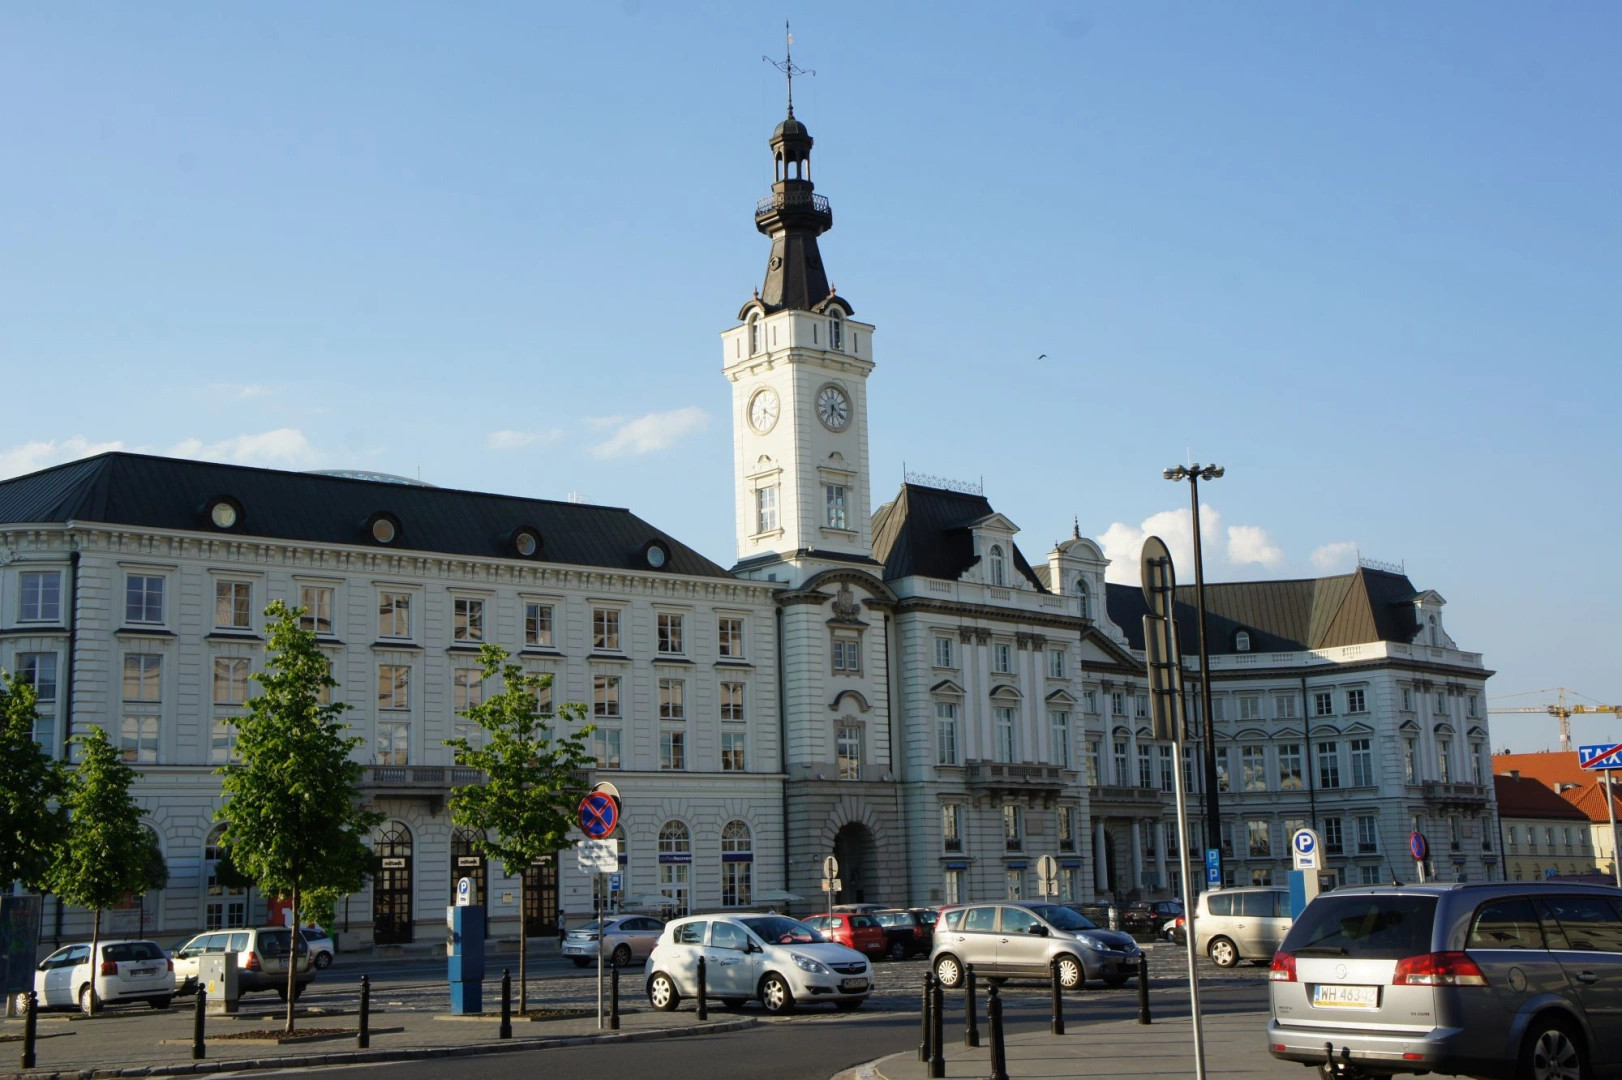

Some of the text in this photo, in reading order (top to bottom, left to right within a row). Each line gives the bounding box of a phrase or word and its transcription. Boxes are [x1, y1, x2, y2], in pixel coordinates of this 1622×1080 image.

[1299, 836, 1312, 850] P
[1209, 851, 1216, 862] P
[1210, 869, 1217, 880] P
[460, 882, 467, 893] P
[1322, 987, 1336, 1001] WH
